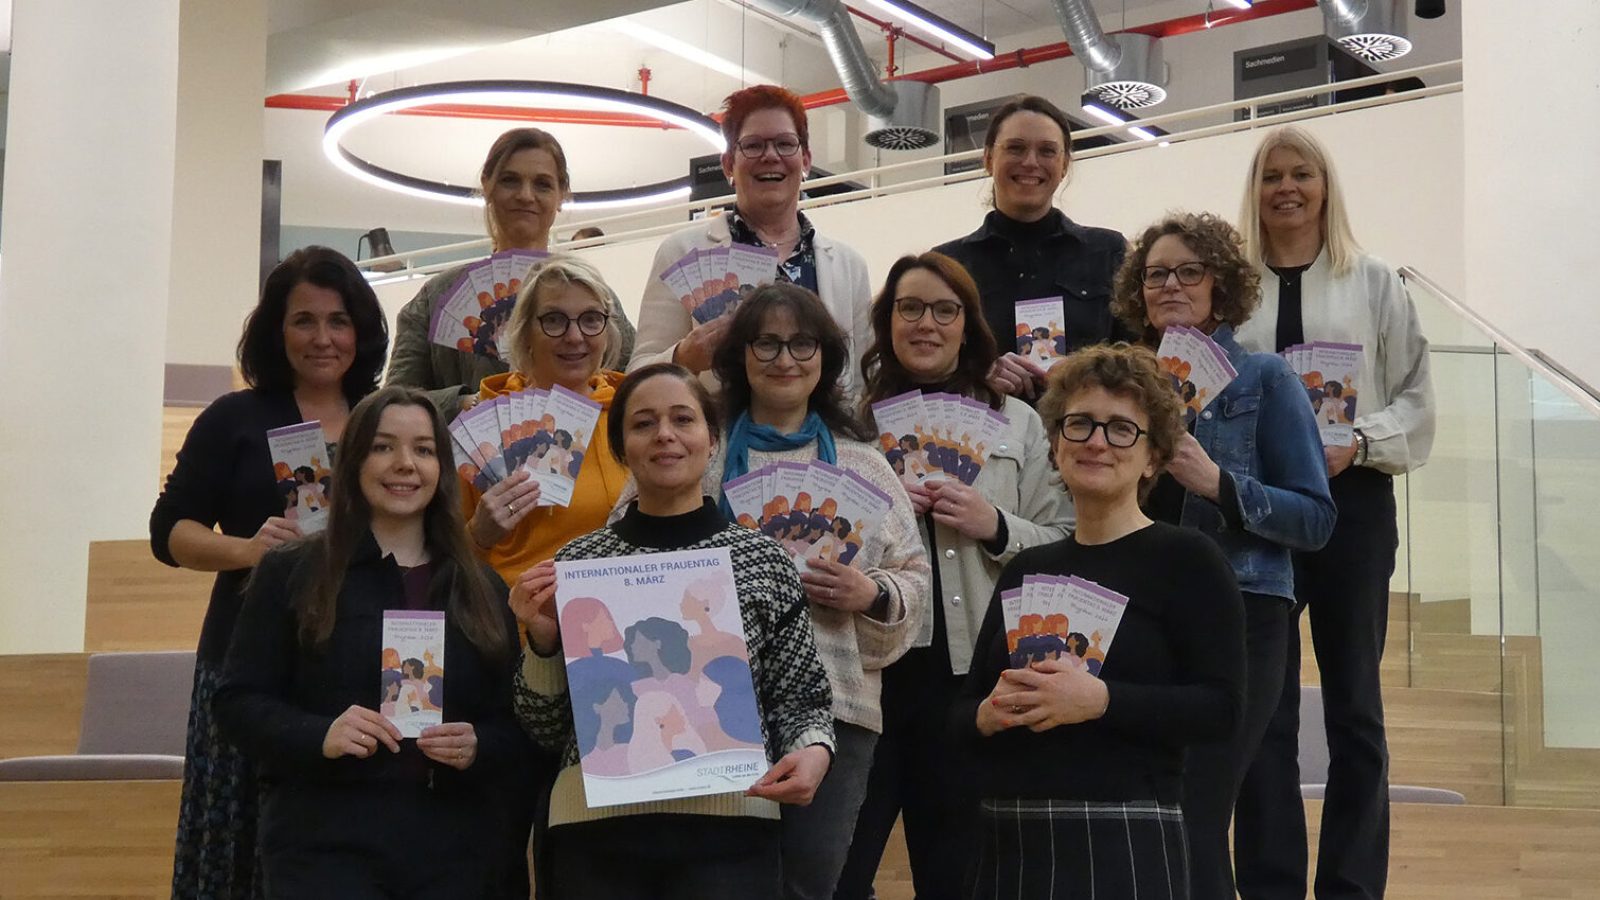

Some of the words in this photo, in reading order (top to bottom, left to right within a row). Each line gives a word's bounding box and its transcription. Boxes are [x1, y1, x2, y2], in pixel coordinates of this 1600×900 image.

[1245, 55, 1285, 68] Sachmedien
[564, 563, 658, 580] INTERNATIONALER
[660, 558, 720, 571] FRAUENTAG
[624, 577, 634, 587] 8.
[636, 574, 665, 586] MÄRZ
